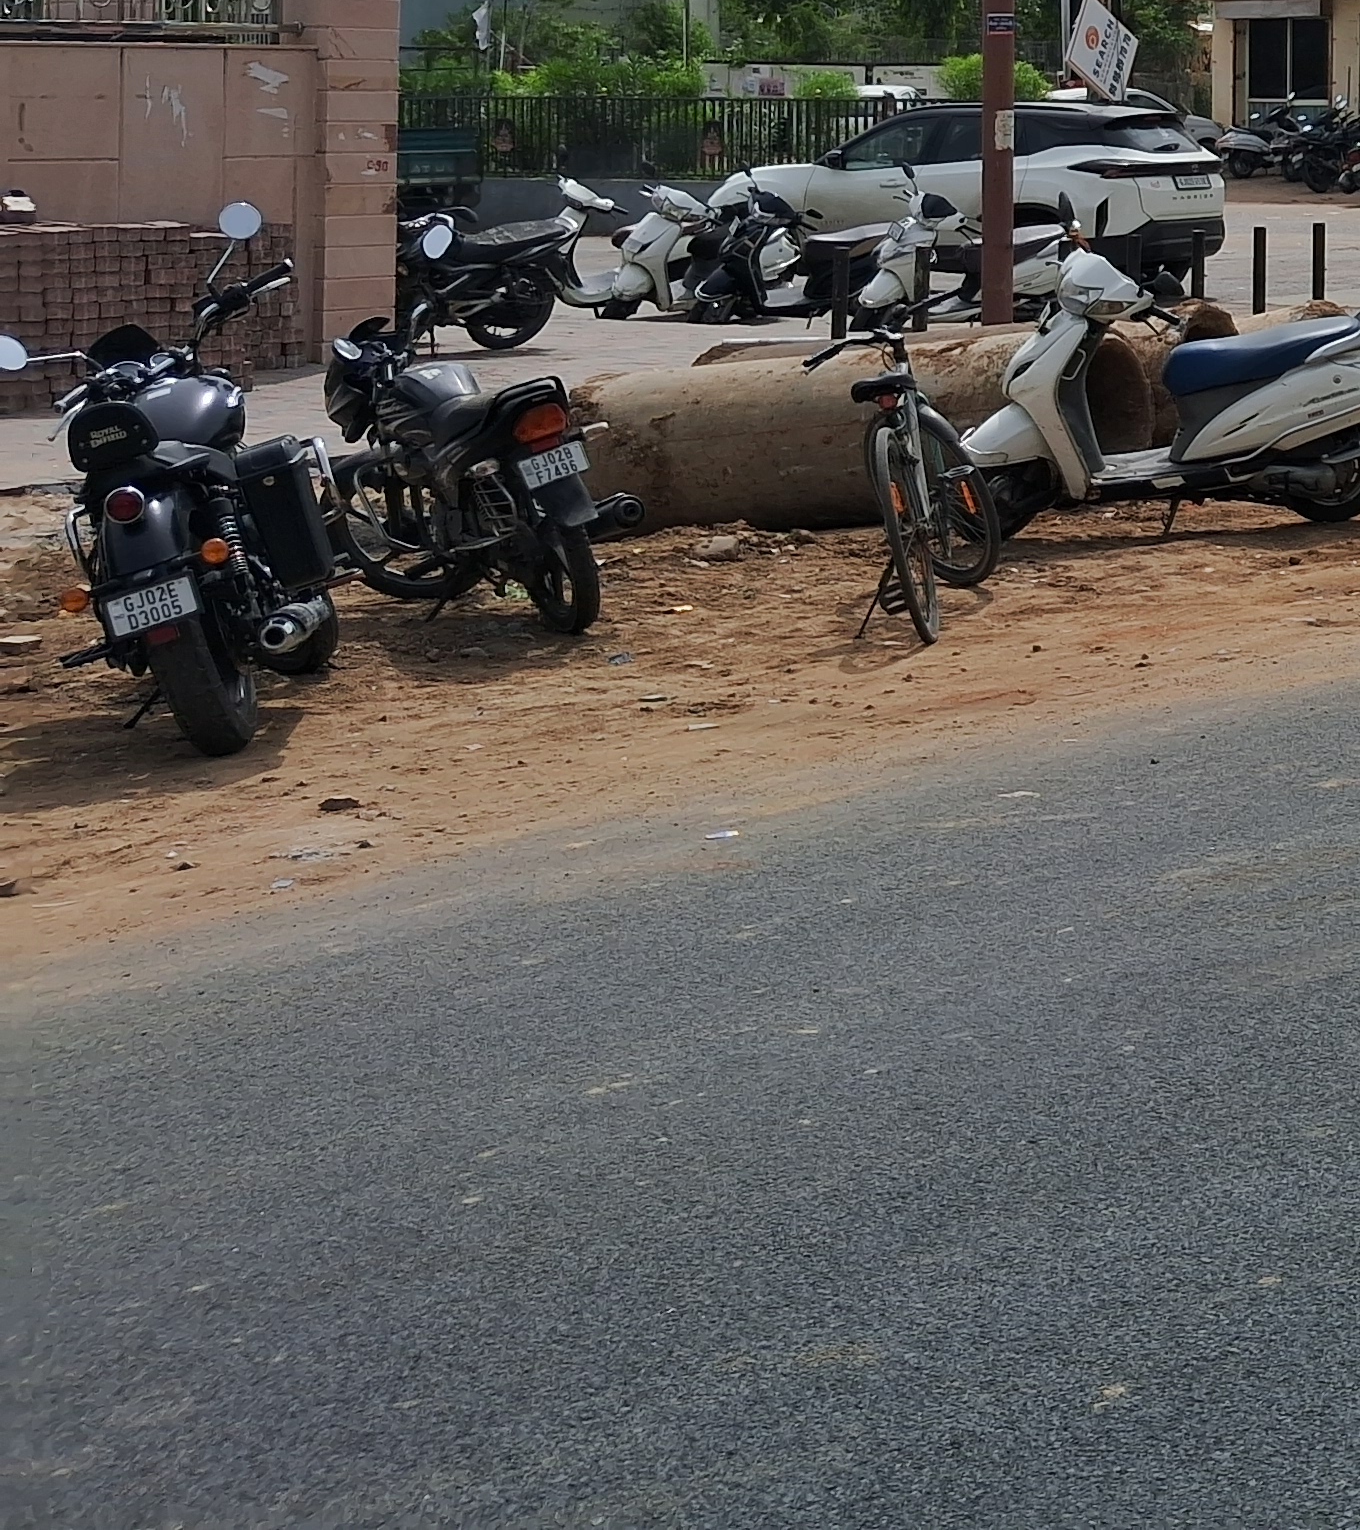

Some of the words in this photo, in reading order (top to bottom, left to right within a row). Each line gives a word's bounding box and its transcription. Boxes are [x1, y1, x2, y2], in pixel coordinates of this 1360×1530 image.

[1093, 19, 1114, 78] SEARCH
[90, 425, 121, 439] ROYAL
[90, 431, 127, 448] ENFIELD
[531, 448, 573, 470] GJ02B
[536, 460, 578, 483] F7496
[124, 582, 178, 612] GJ02E
[128, 599, 182, 630] D3005
